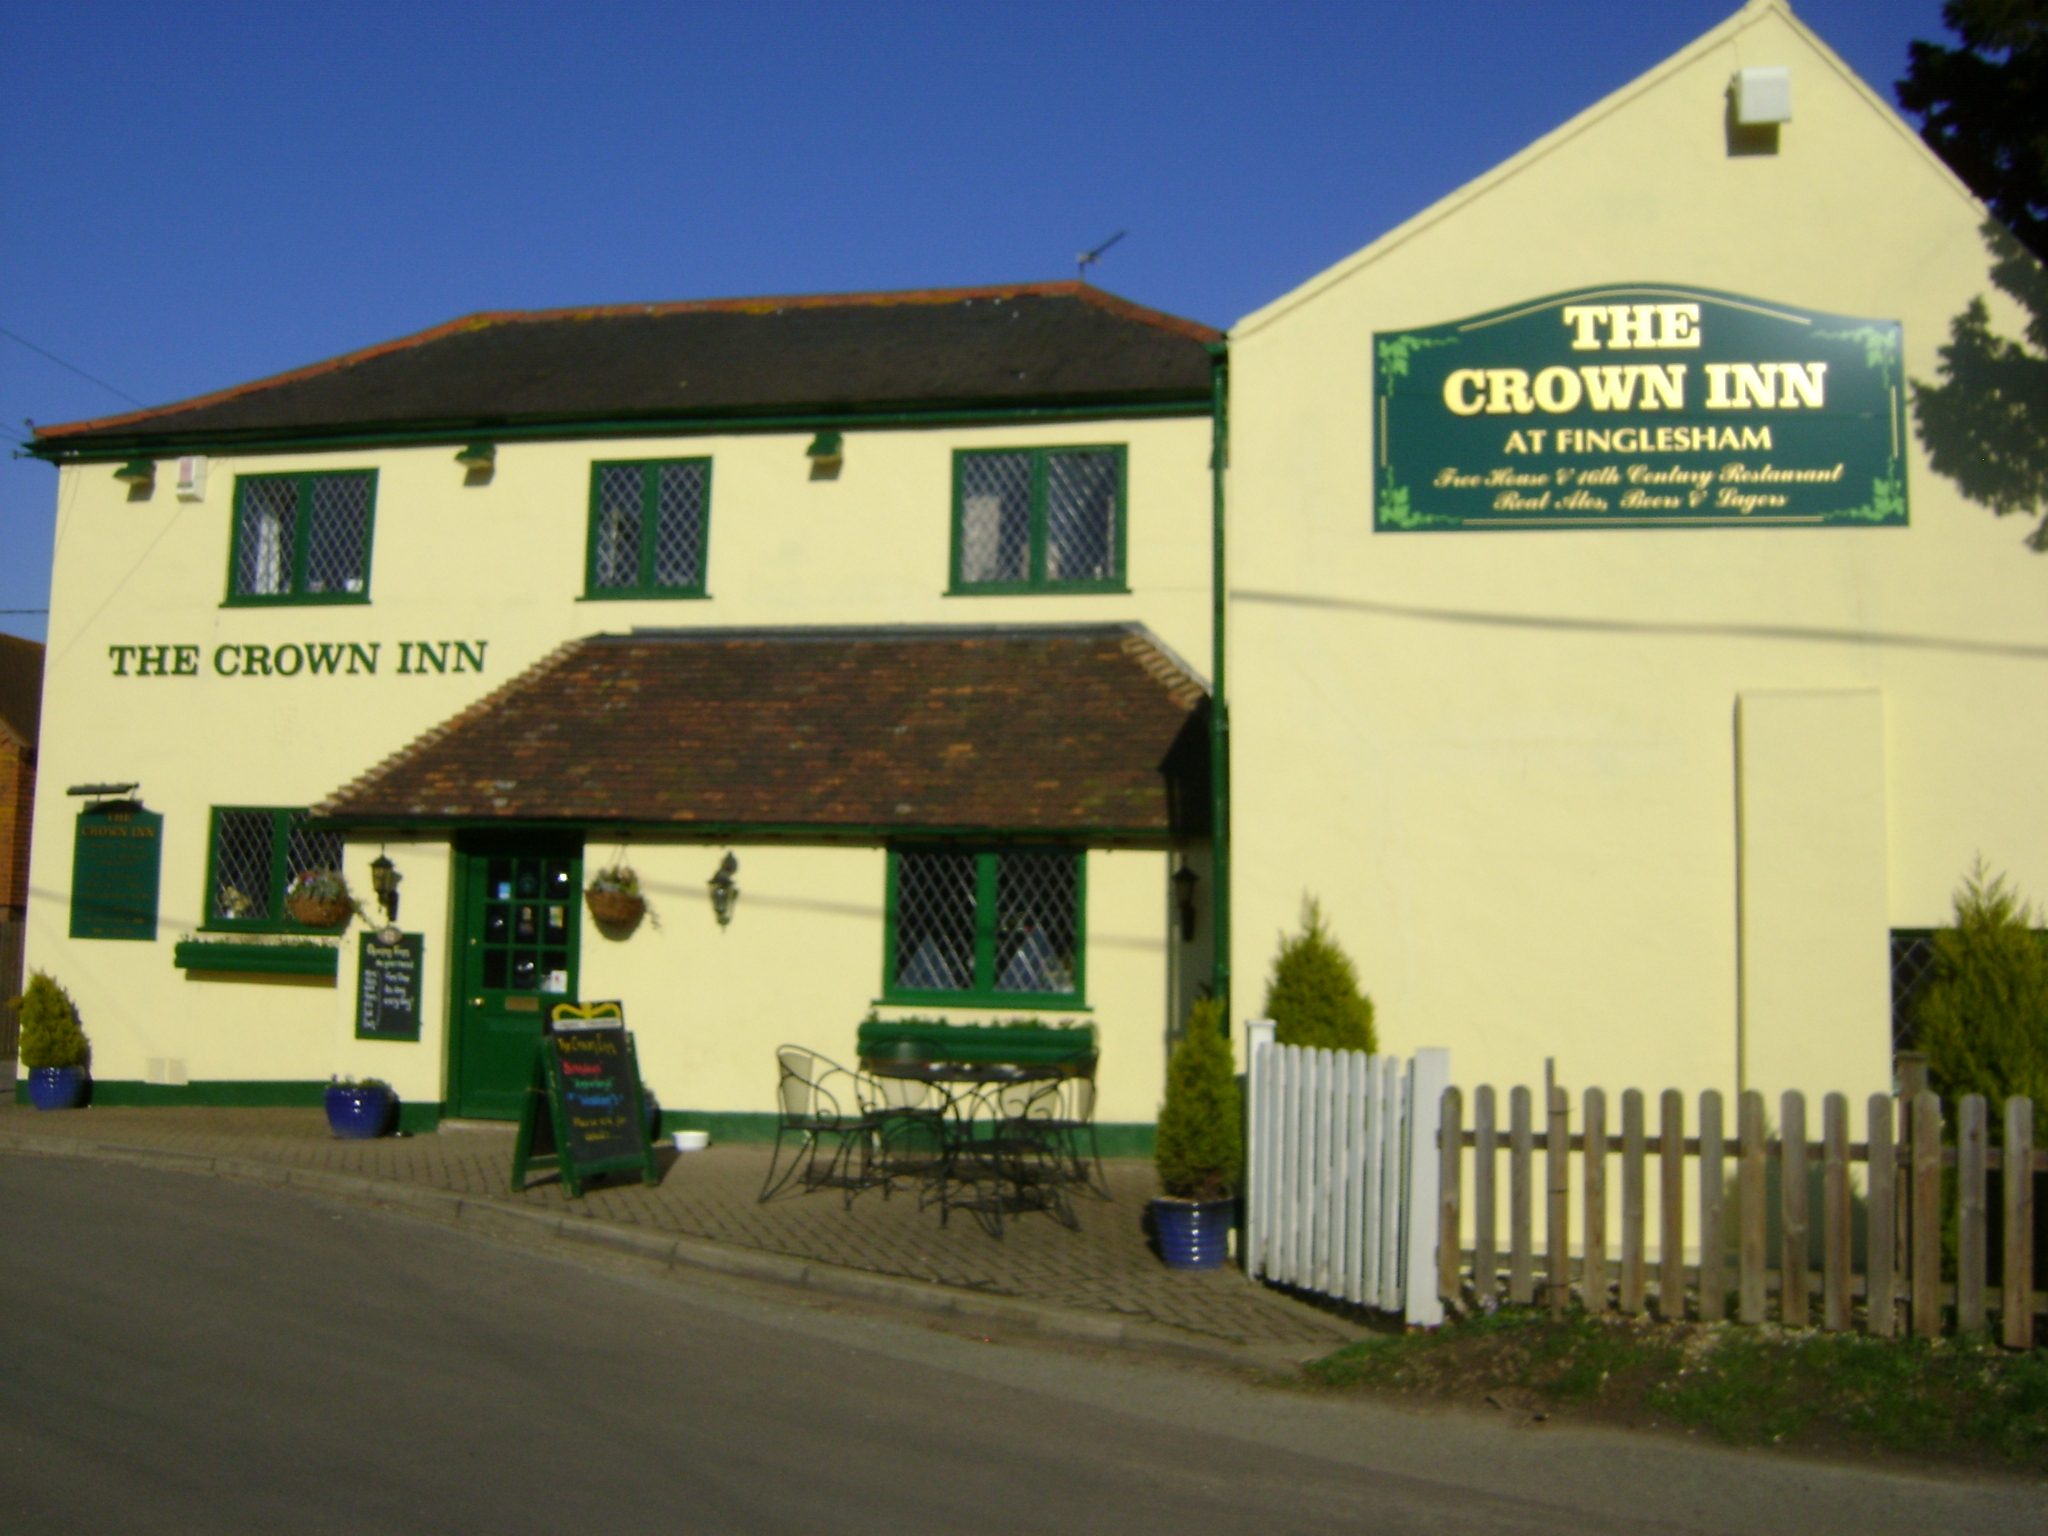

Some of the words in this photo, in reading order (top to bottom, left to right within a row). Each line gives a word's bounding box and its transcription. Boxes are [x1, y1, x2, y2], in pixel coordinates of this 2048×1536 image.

[1563, 303, 1701, 350] THE
[1443, 363, 1688, 415] CROWN
[1704, 362, 1828, 409] INN
[1504, 431, 1547, 454] AT
[1557, 425, 1773, 453] FINGLESHAM
[1433, 466, 1482, 488] Free
[1484, 467, 1549, 487] House
[1626, 463, 1715, 490] Century
[1718, 461, 1845, 484] Restaurant
[1493, 489, 1552, 511] Real
[1619, 487, 1682, 510] Beers
[1715, 486, 1789, 515] Lagers
[108, 645, 200, 677] THE
[213, 642, 381, 677] CROWN
[396, 640, 488, 675] INN
